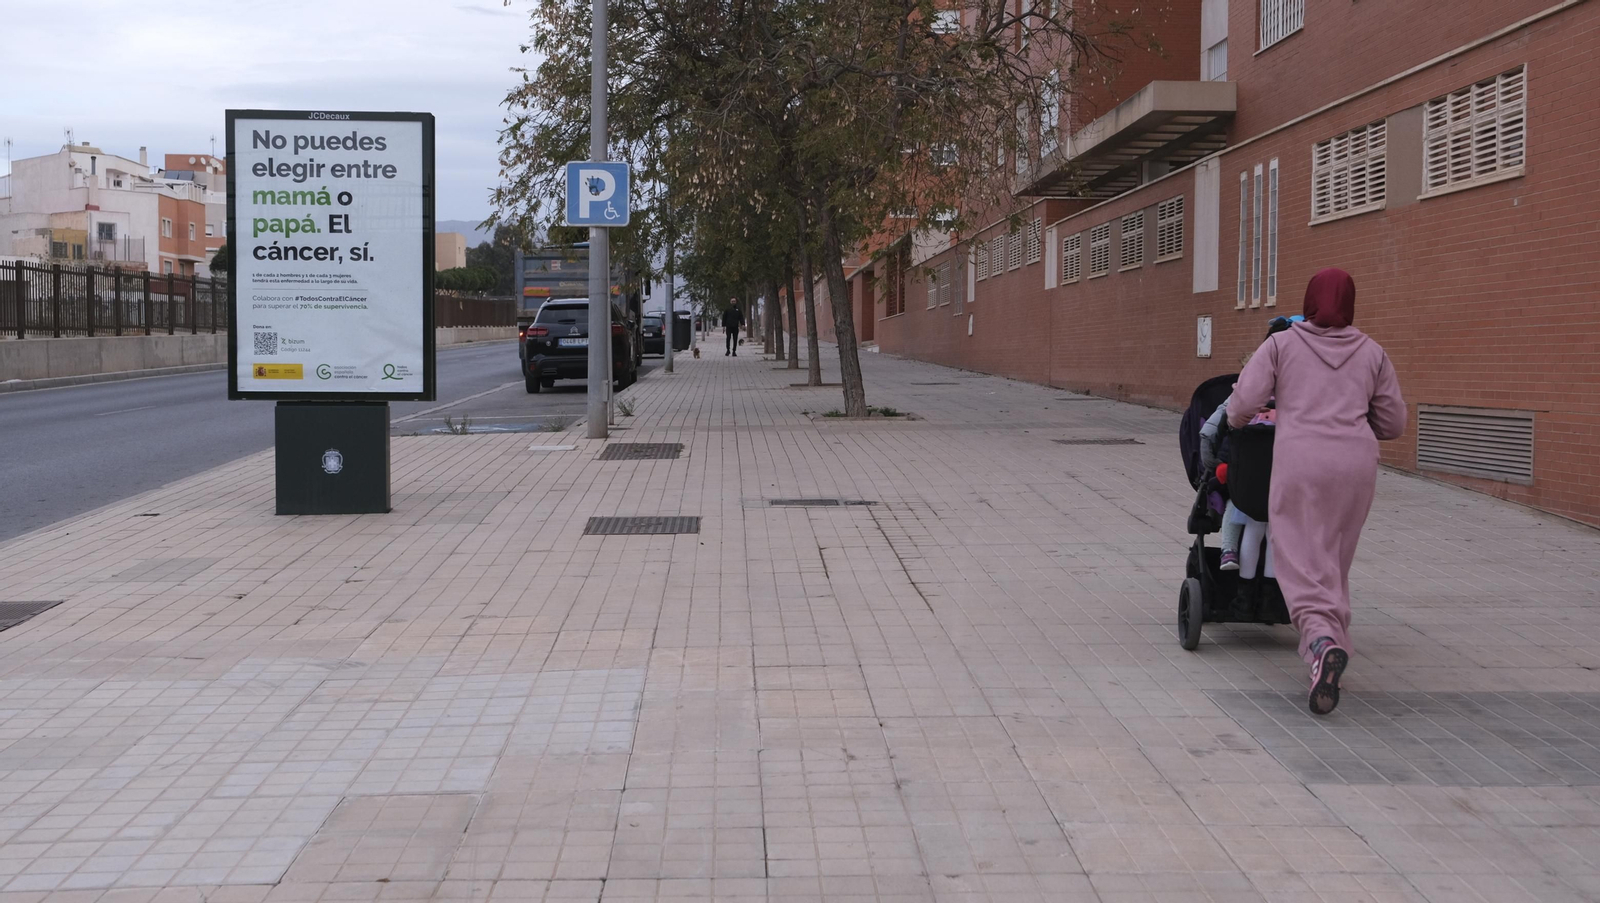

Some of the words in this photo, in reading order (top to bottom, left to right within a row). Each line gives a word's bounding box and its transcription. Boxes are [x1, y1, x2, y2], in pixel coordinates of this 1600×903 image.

[308, 112, 350, 120] JCDecaux
[252, 129, 287, 150] No
[293, 131, 387, 155] puedes
[252, 157, 325, 183] elegir
[330, 160, 397, 179] entre
[252, 185, 332, 206] mamá
[337, 191, 353, 206] o
[579, 169, 616, 218] P
[252, 213, 321, 238] papá.
[328, 214, 352, 234] El
[252, 241, 343, 265] cáncer,
[349, 242, 374, 262] sí.
